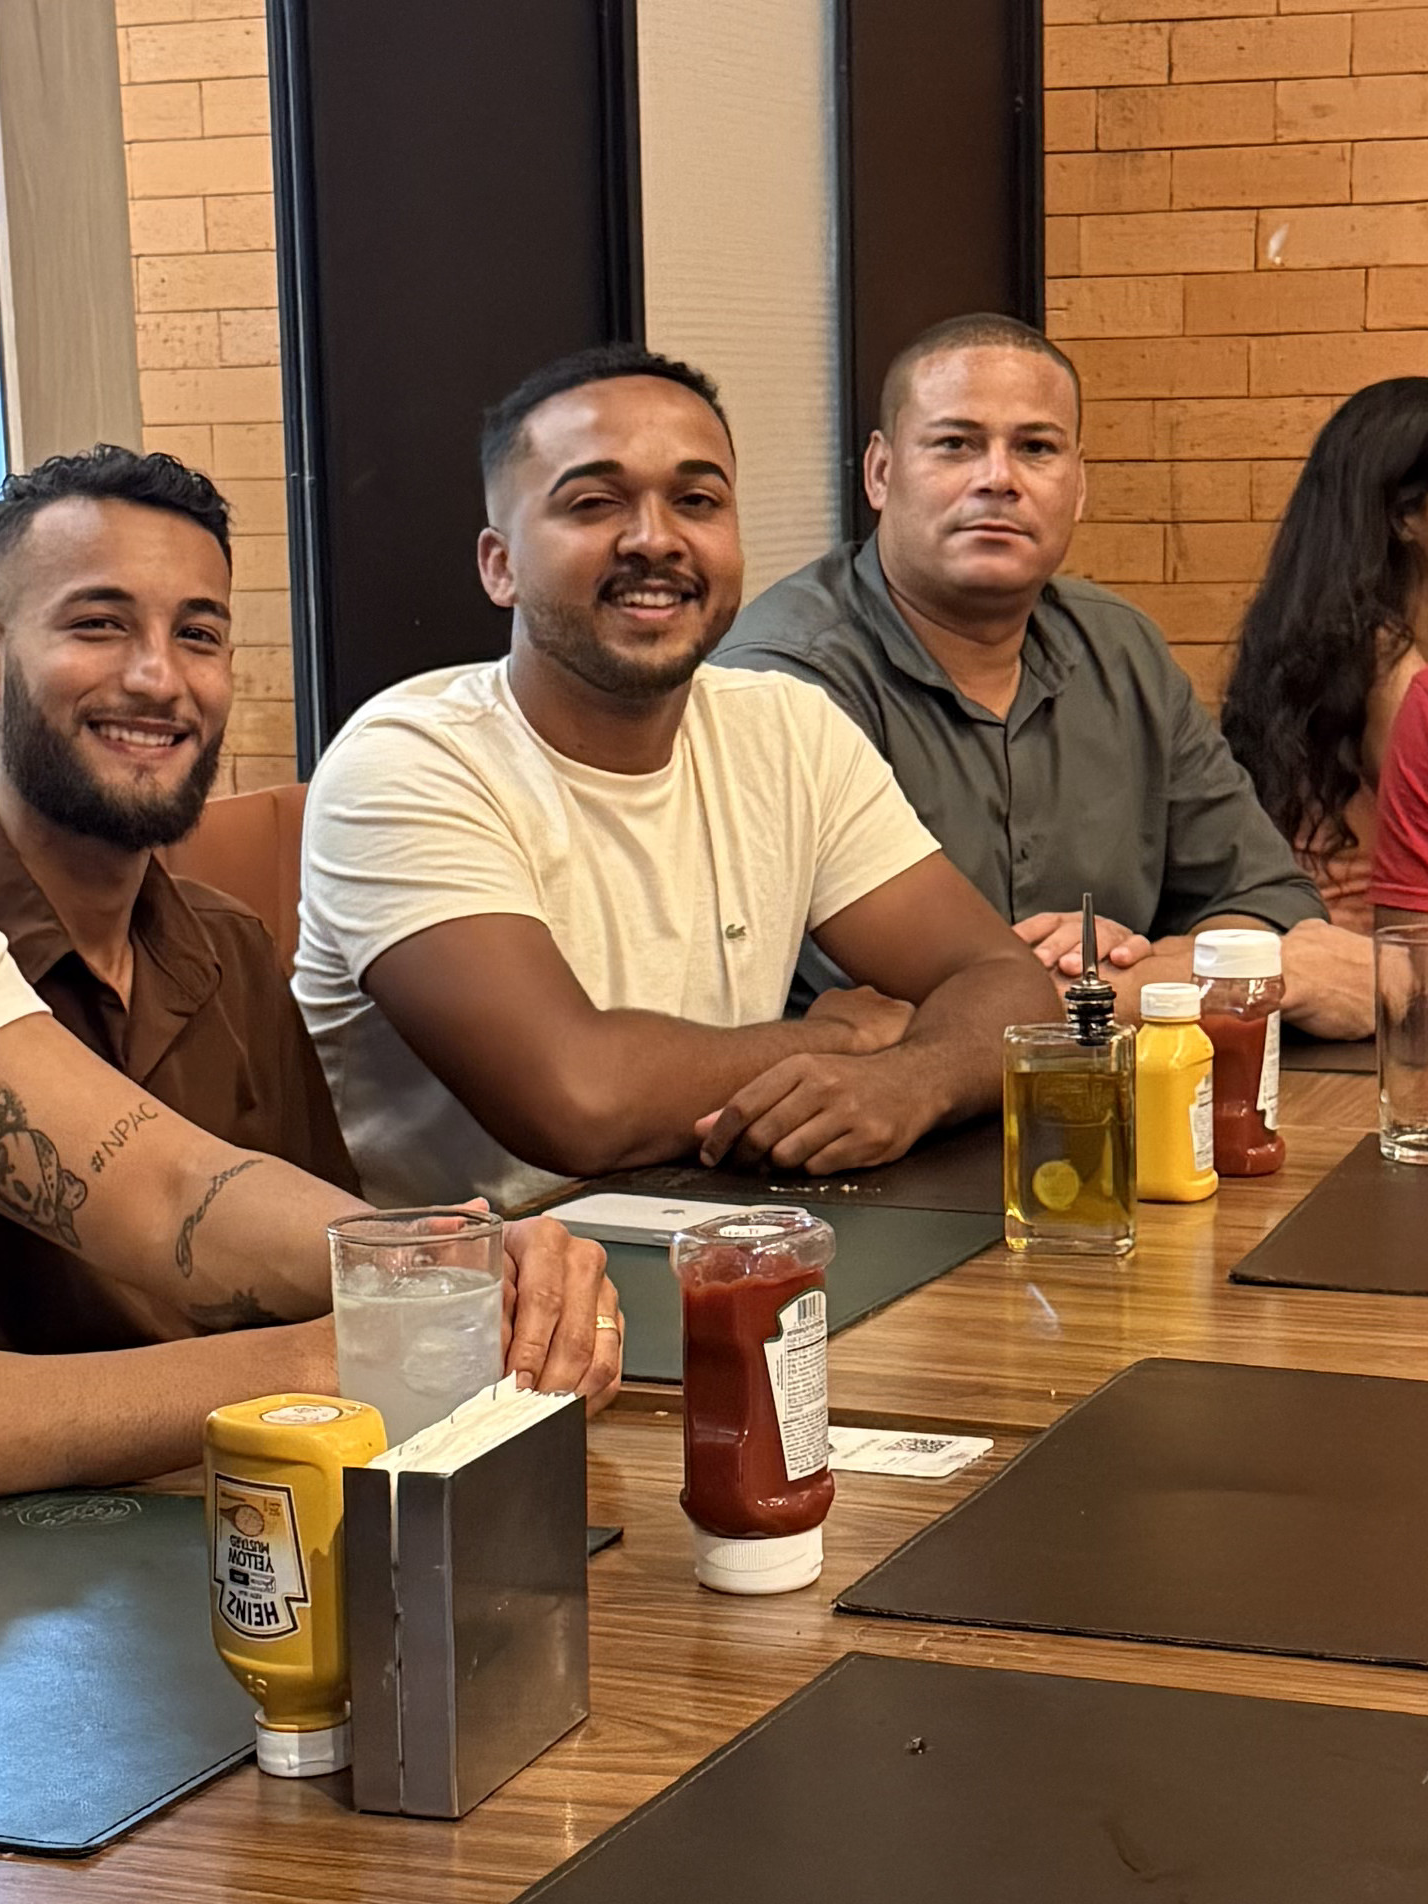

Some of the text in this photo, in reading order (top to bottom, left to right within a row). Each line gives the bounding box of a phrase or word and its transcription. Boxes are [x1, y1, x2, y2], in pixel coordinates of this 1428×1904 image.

[89, 1100, 160, 1174] #NPAC
[227, 1547, 275, 1574] YELLOW
[226, 1590, 280, 1627] HEINZ
